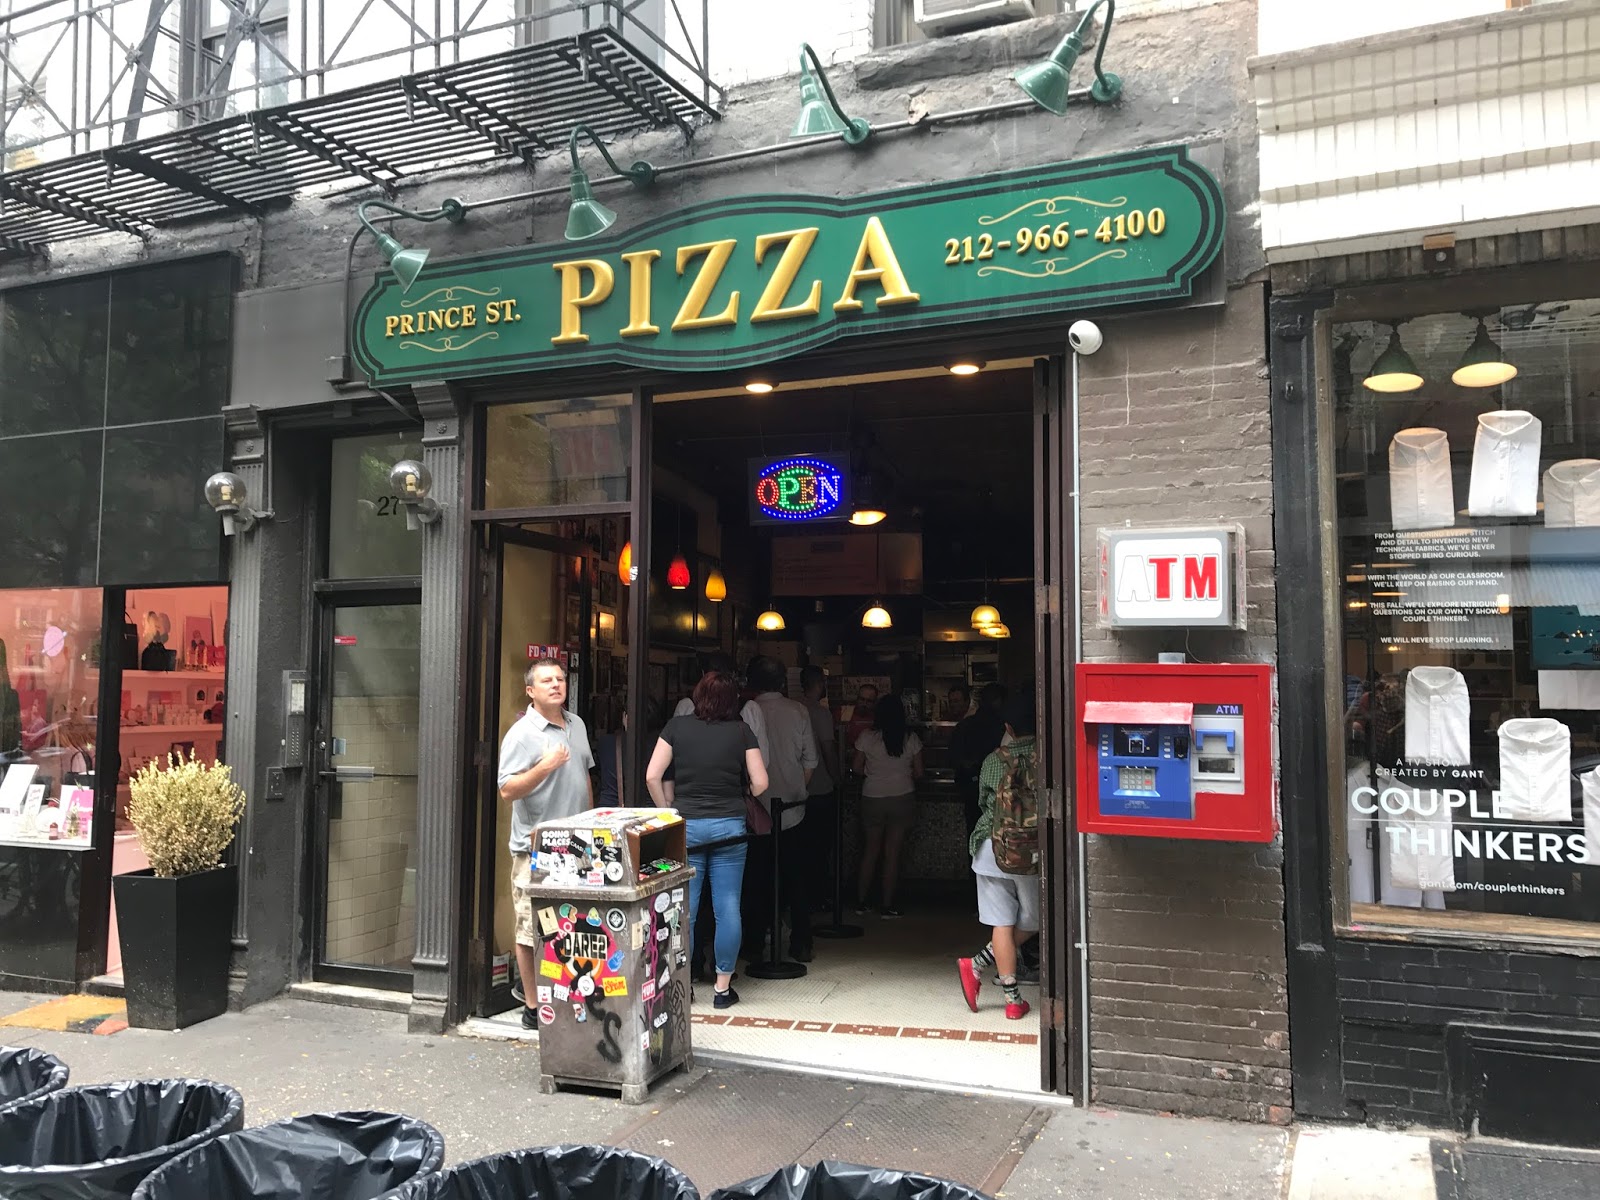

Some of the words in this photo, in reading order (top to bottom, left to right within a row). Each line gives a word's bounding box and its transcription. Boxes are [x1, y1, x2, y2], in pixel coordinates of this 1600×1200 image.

[944, 207, 1166, 265] 212-966-4100
[551, 216, 920, 346] PIZZA
[385, 303, 476, 338] PRINCE
[485, 299, 522, 325] ST.
[756, 475, 841, 506] OPEN
[1116, 554, 1220, 602] ATM
[1373, 608, 1413, 616] QUESTIONS
[1215, 705, 1239, 714] ATM
[1374, 767, 1428, 777] CREATED
[1432, 768, 1447, 778] BY
[1451, 769, 1484, 779] GANT
[1396, 758, 1403, 766] A
[1405, 758, 1421, 767] TV
[1425, 758, 1462, 767] SHOW
[1351, 786, 1513, 819] COUPLE
[541, 830, 569, 838] GOING
[542, 838, 570, 847] PLACES
[1385, 826, 1591, 864] THINKERS
[1419, 880, 1565, 896] gant.com/couplethinkers
